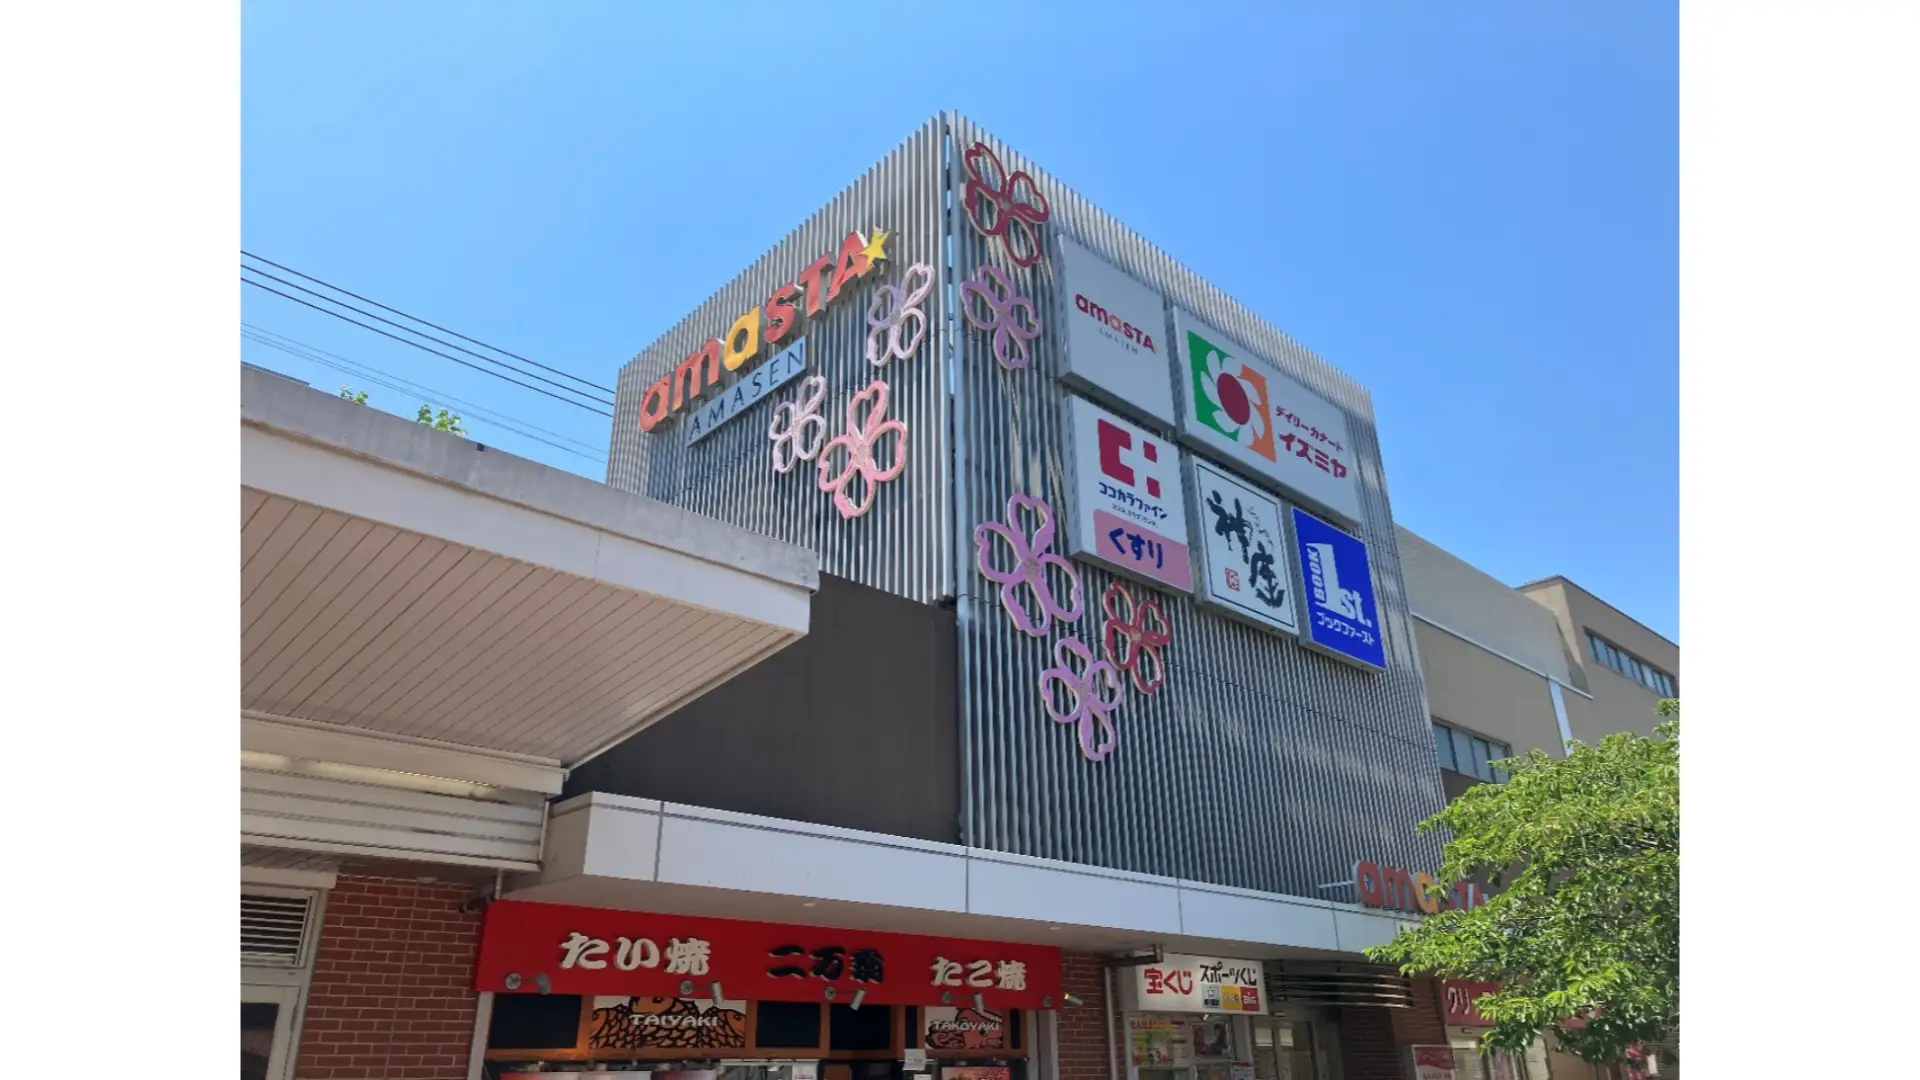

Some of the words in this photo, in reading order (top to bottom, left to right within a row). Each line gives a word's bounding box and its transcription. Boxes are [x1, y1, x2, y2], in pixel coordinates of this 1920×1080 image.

[687, 346, 804, 440] AMASEN
[1279, 432, 1347, 478] イズミヤ
[1098, 481, 1168, 520] ココカラファイン
[1108, 527, 1163, 569] くすり
[1306, 547, 1326, 603] BOOK
[1316, 611, 1375, 646] ブックファースト
[559, 932, 712, 976] たい焼
[930, 956, 1027, 991] たこ焼
[1199, 961, 1257, 986] スポーツくじ
[1144, 967, 1193, 995] 宝くじ
[628, 1014, 719, 1027] TAIYAKI
